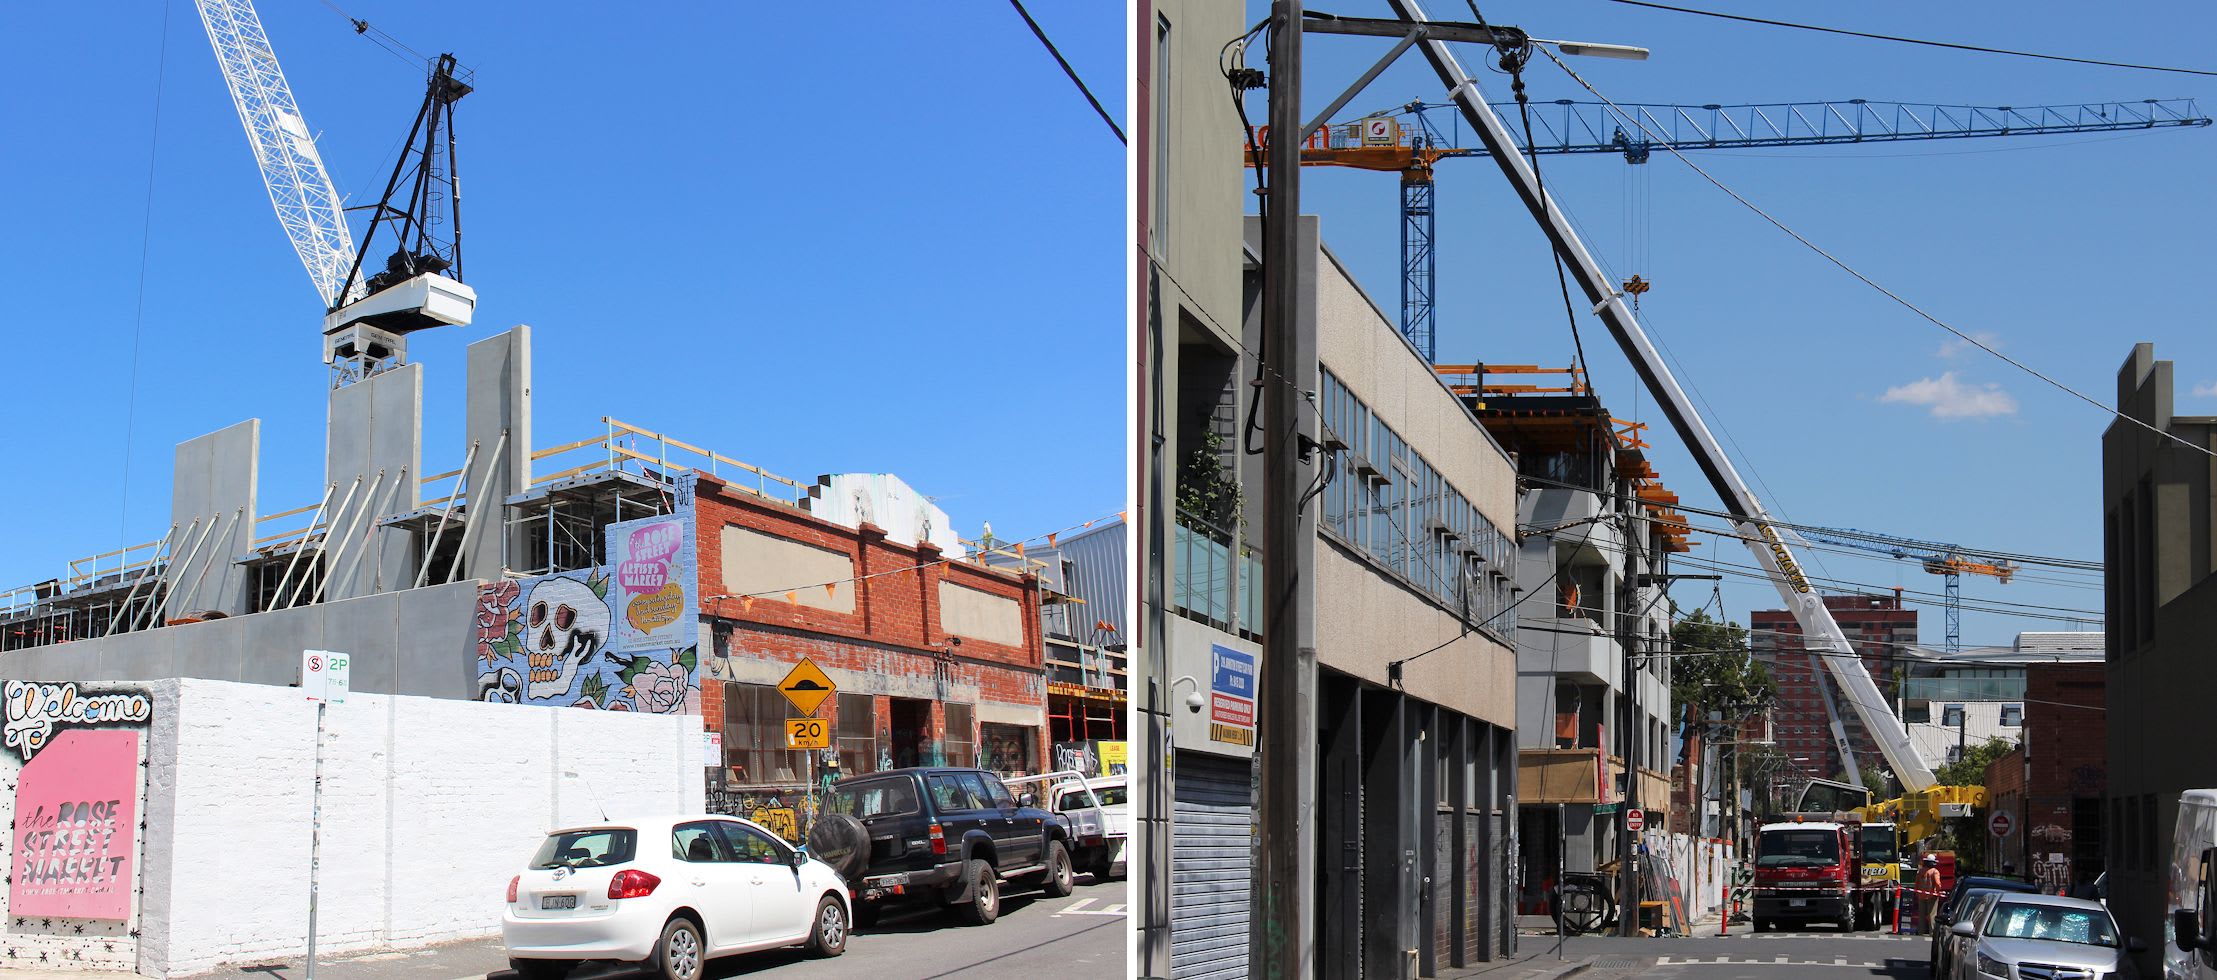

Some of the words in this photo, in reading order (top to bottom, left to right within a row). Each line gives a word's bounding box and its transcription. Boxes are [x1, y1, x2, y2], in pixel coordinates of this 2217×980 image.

[371, 332, 396, 346] GENRAL
[644, 526, 674, 546] ROSE
[635, 542, 671, 561] STREET
[622, 562, 659, 574] ARTISTS
[624, 574, 664, 586] MARKET
[330, 658, 348, 671] 2P
[8, 681, 147, 721] Welcome
[8, 721, 47, 756] To
[795, 723, 821, 737] 20
[22, 806, 55, 828] the
[57, 800, 120, 828] ROSE
[21, 828, 116, 858] STREET
[21, 856, 125, 885] MARKET
